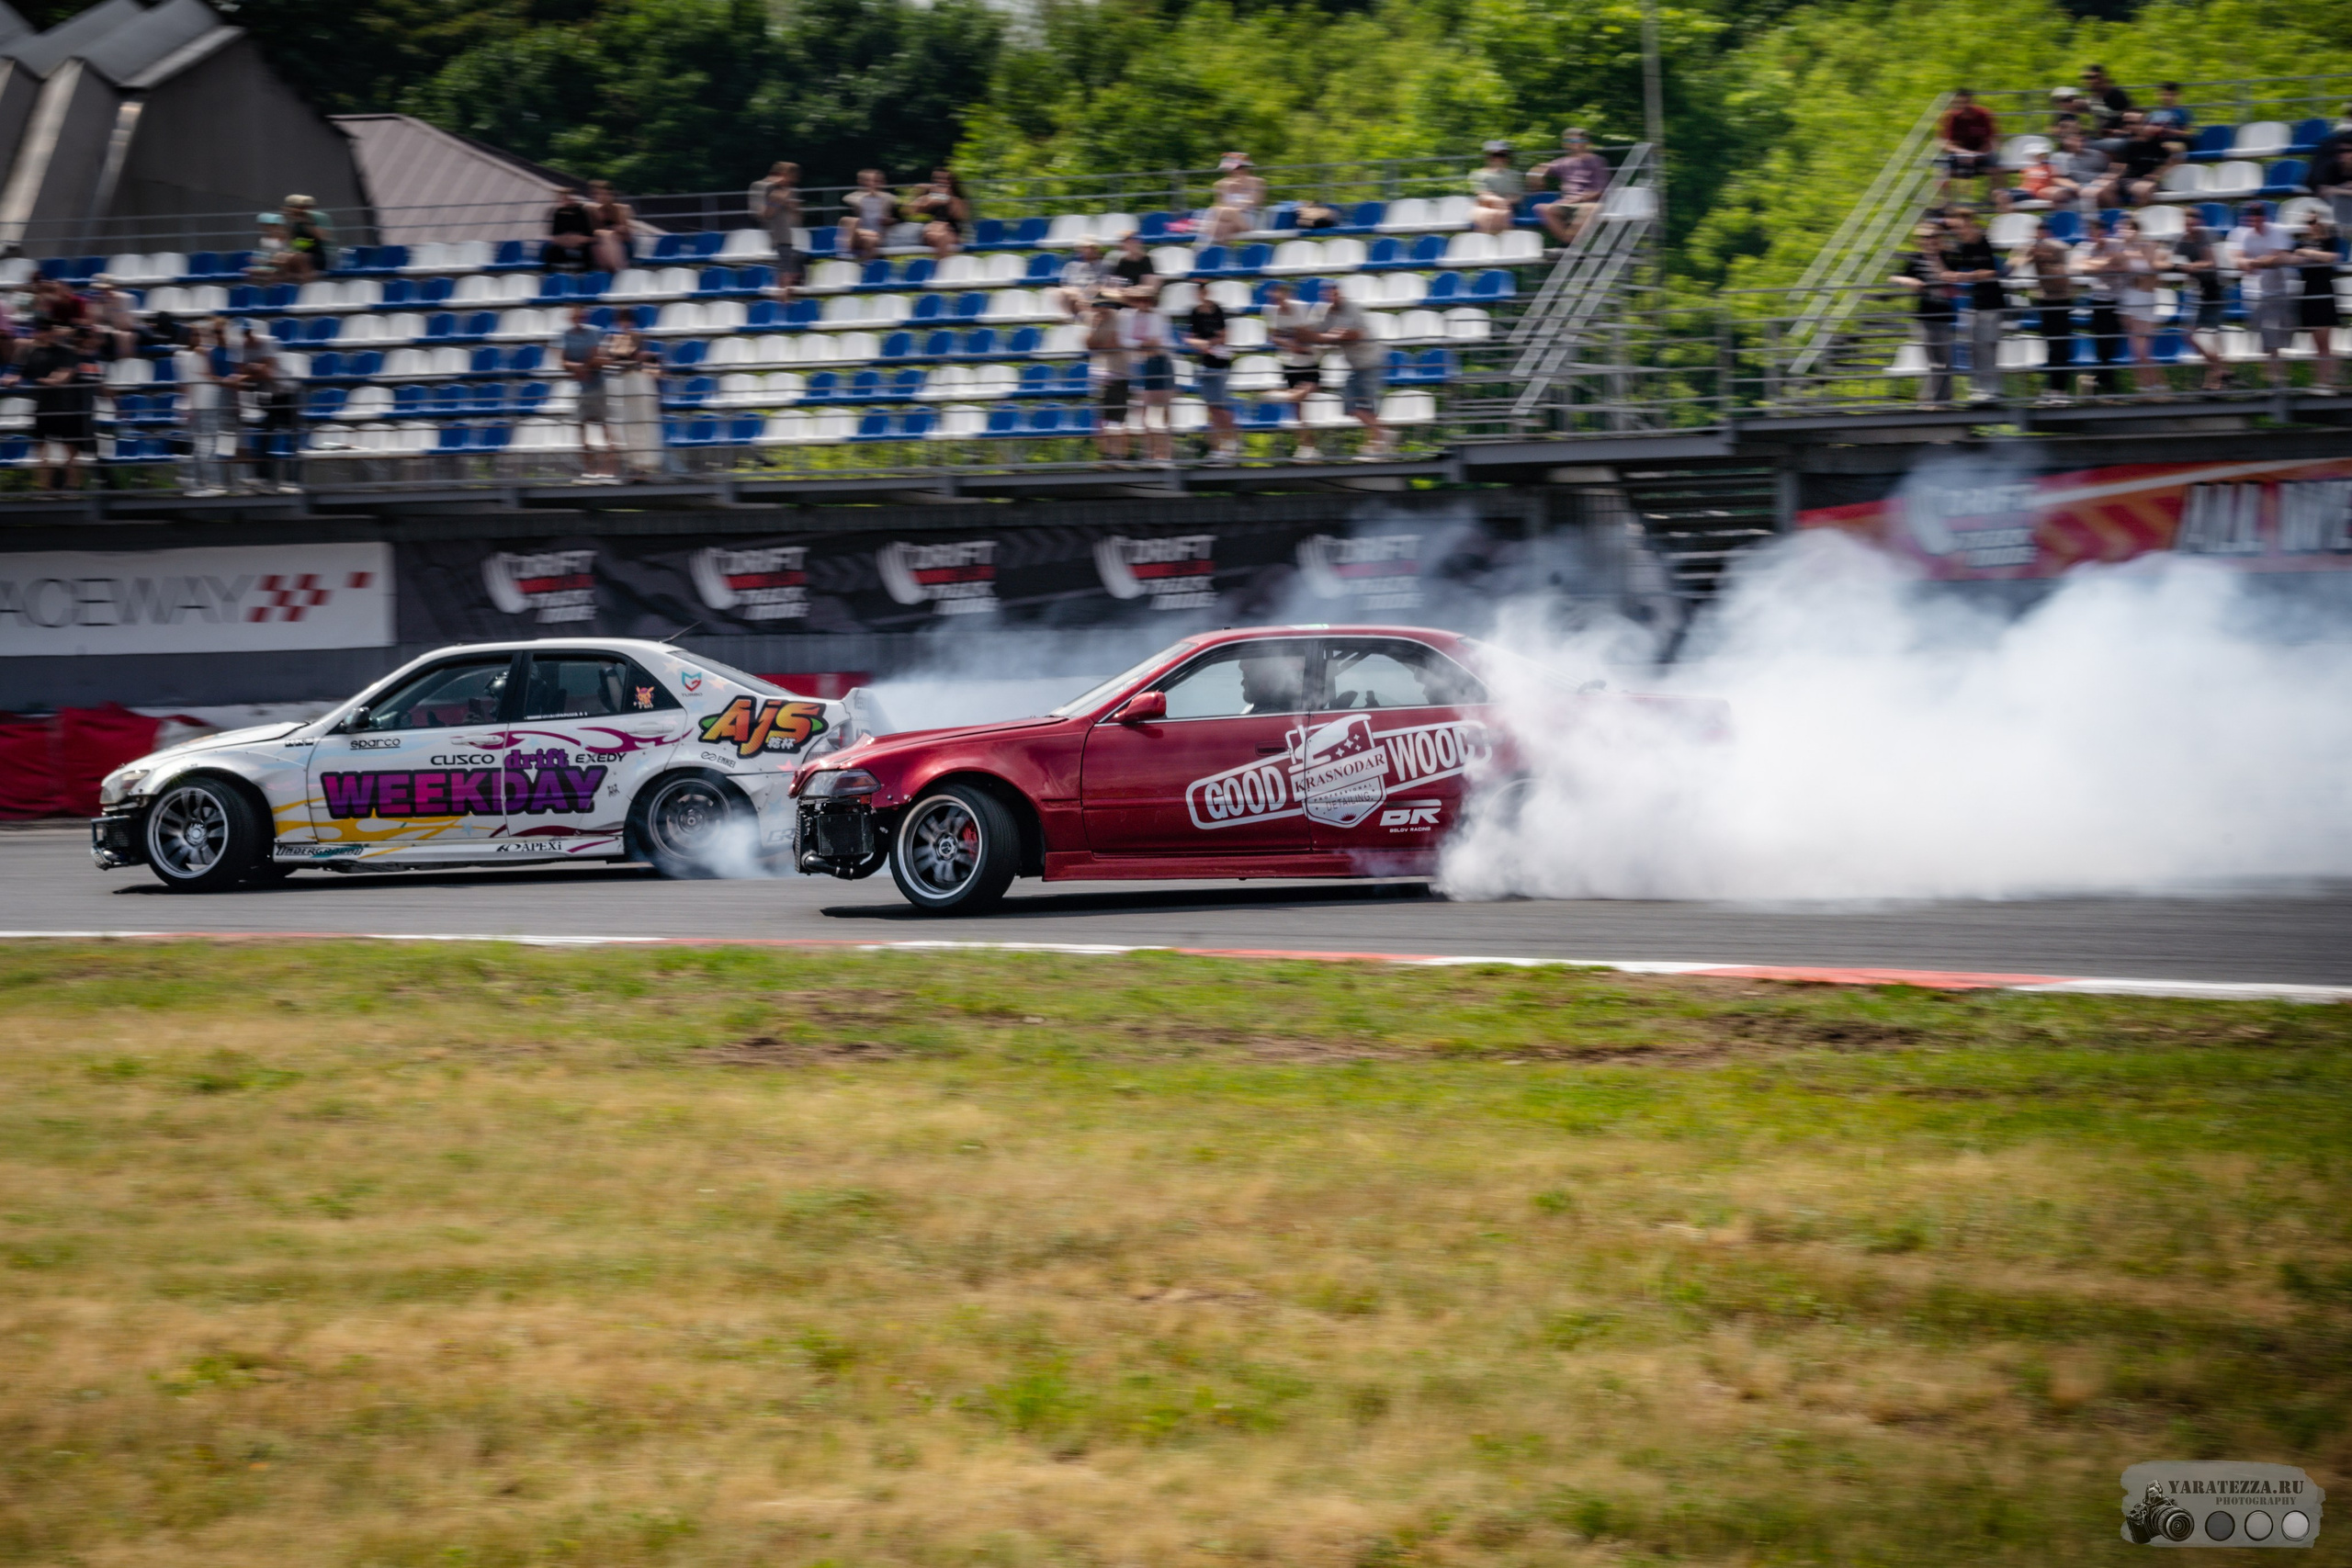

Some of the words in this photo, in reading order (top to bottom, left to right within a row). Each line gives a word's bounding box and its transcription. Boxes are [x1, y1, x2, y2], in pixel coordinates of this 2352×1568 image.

[350, 738, 401, 750] sparco
[1385, 727, 1476, 782] WOOD
[430, 753, 495, 765] CUSCO
[504, 748, 570, 770] drift
[575, 752, 628, 764] EXEDY
[1295, 753, 1385, 794] KRASNODAR
[322, 766, 607, 818] WEEKDAY
[1204, 766, 1286, 819] GOOD
[1314, 783, 1373, 803] PROFESSIONAL
[1326, 792, 1371, 811] DETAILING
